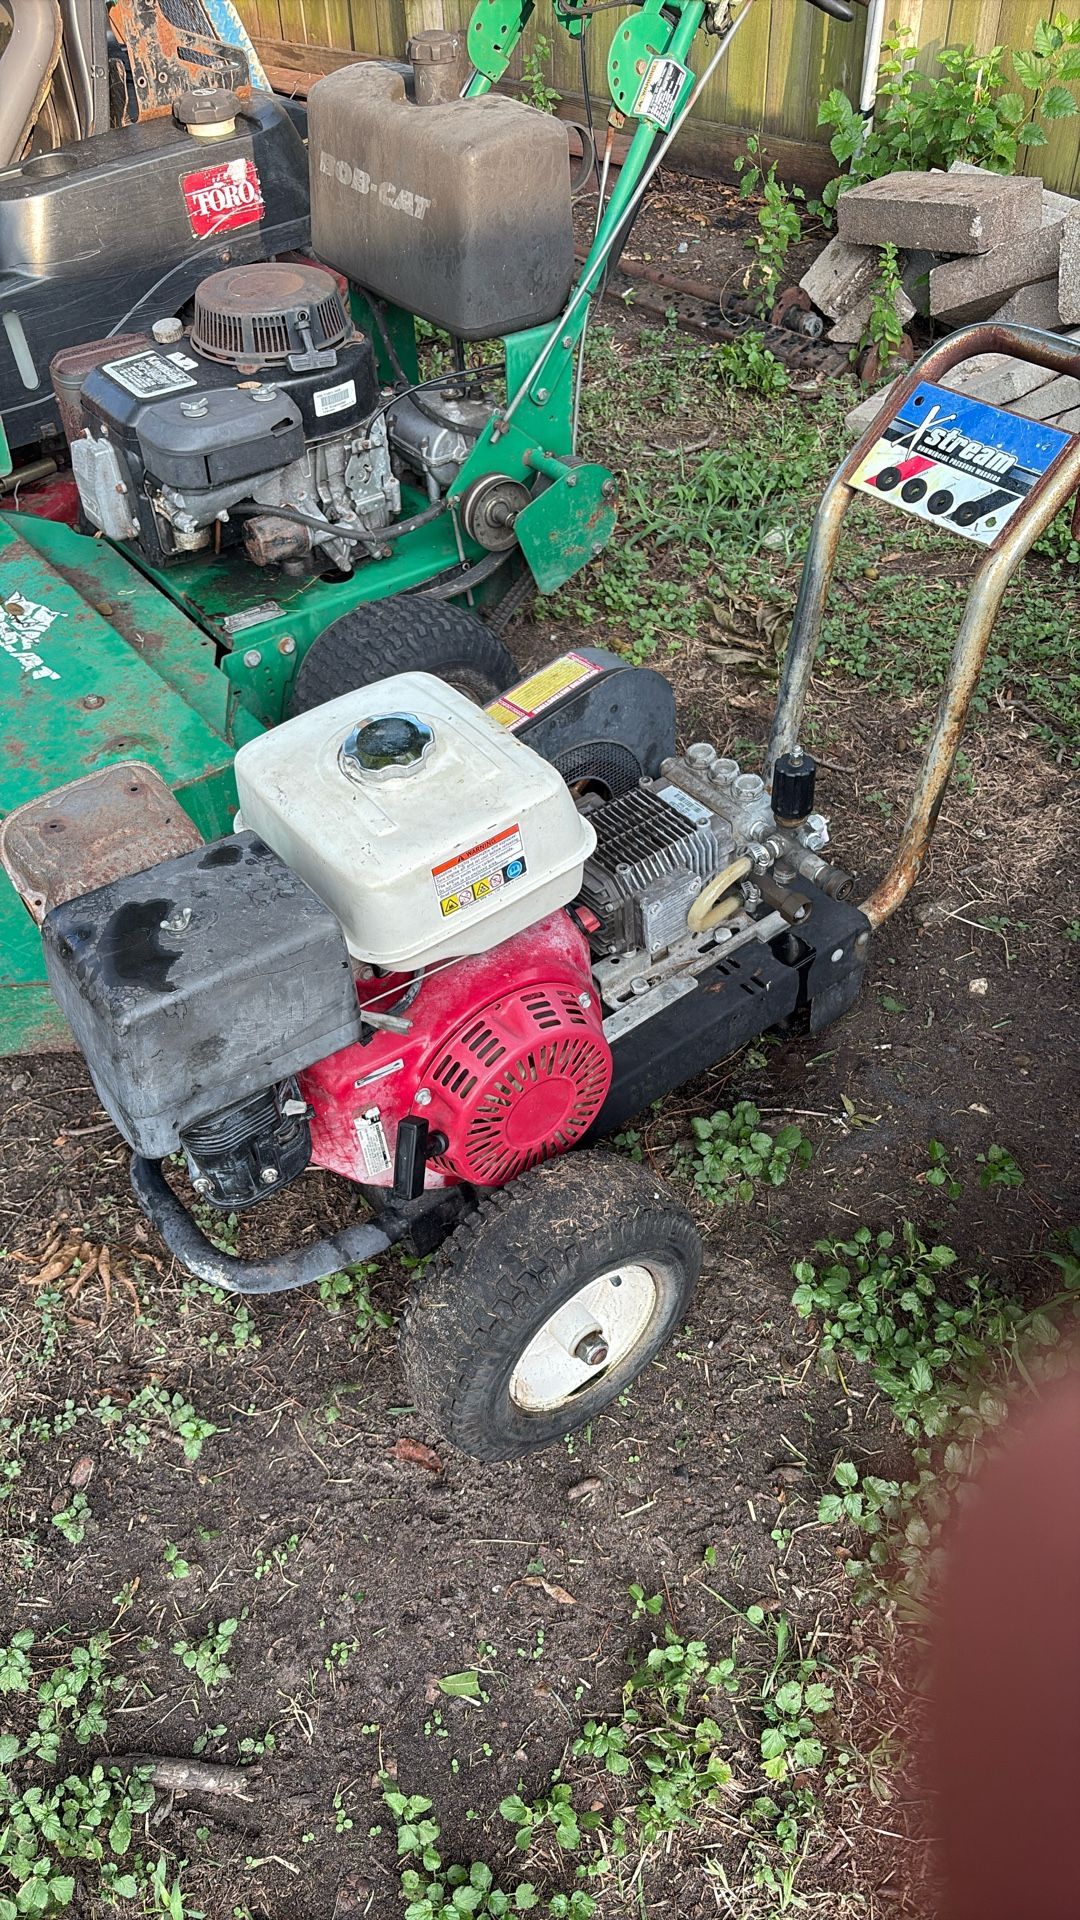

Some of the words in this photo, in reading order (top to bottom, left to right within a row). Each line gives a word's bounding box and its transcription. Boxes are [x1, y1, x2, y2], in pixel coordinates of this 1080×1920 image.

[917, 445, 950, 462] COMMERCIAL
[949, 457, 976, 473] PRESSURE
[974, 466, 1001, 483] WASHERS
[466, 838, 496, 857] WARNING
